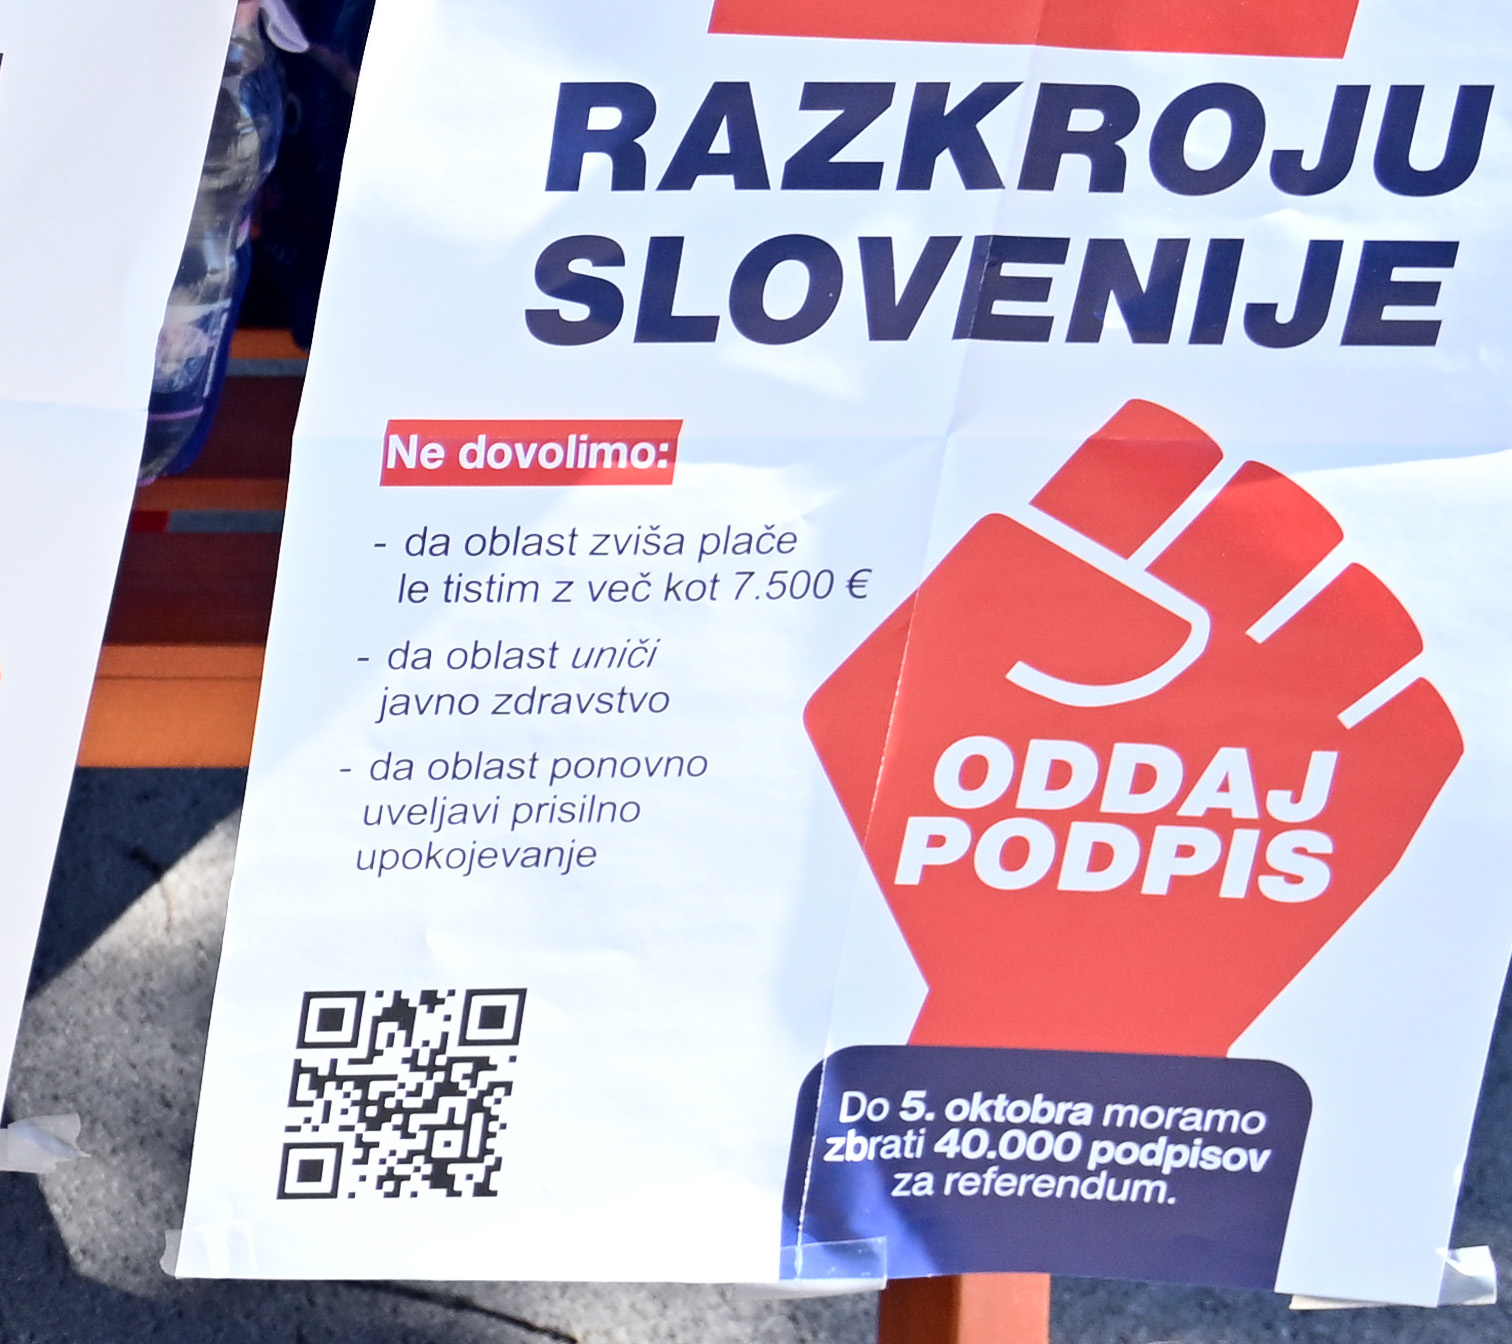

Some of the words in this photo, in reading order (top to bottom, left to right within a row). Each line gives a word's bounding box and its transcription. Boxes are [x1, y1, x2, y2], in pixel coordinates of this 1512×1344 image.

[546, 82, 1494, 196] RAZKROJU
[525, 234, 1459, 348] SLOVENIJE
[387, 434, 445, 469] Ne
[459, 434, 668, 469] dovolimo:
[934, 736, 1337, 822] ODDAJ
[894, 817, 1333, 902] PODPIS
[839, 1091, 889, 1123] Do
[899, 1091, 935, 1121] 5.
[945, 1092, 1093, 1125] oktobra
[1103, 1104, 1266, 1134] moramo
[824, 1128, 925, 1162] zbrati
[934, 1128, 1082, 1162] 40.000
[1087, 1136, 1271, 1174] podpisov
[891, 1172, 934, 1196] za
[944, 1166, 1175, 1204] referendum.
